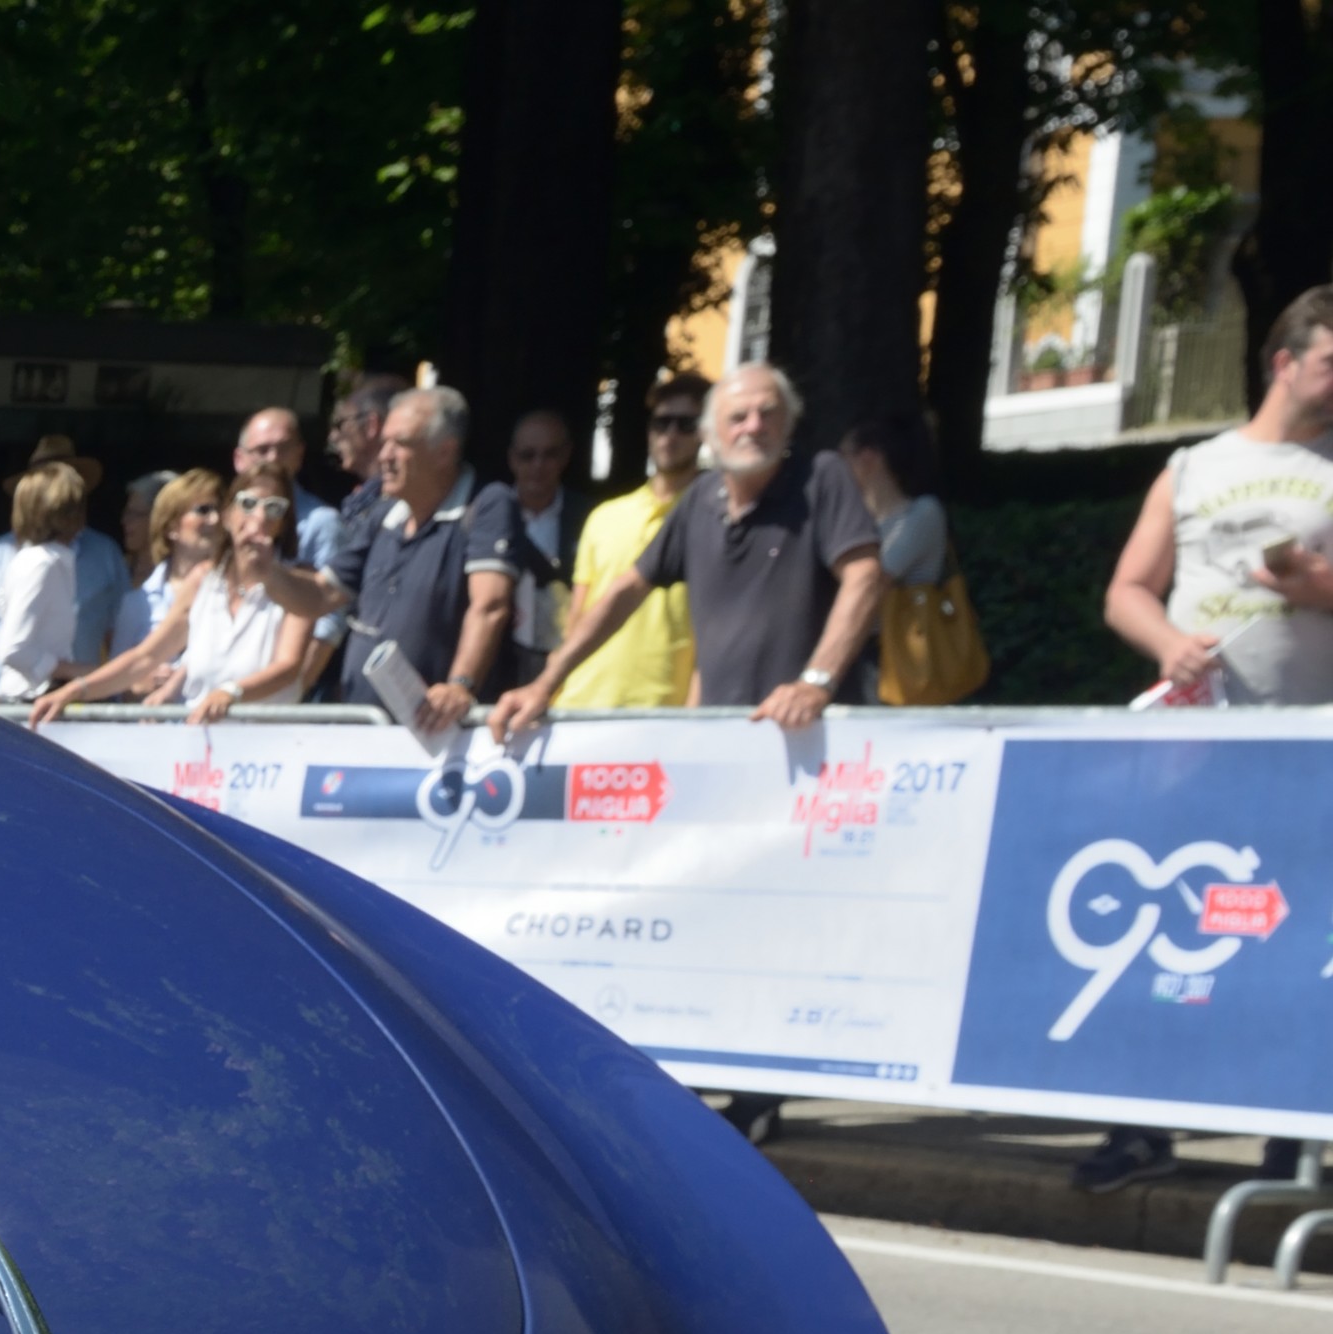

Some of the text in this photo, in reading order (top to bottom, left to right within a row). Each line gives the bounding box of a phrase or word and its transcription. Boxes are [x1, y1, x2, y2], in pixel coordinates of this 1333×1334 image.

[230, 763, 282, 790] 2017
[580, 766, 649, 791] 1000
[818, 740, 967, 793] Mille 2017
[574, 795, 651, 819] MIGLIA
[791, 794, 879, 858] Miglia
[1214, 889, 1269, 907] 1000
[506, 911, 674, 942] CHOPARD
